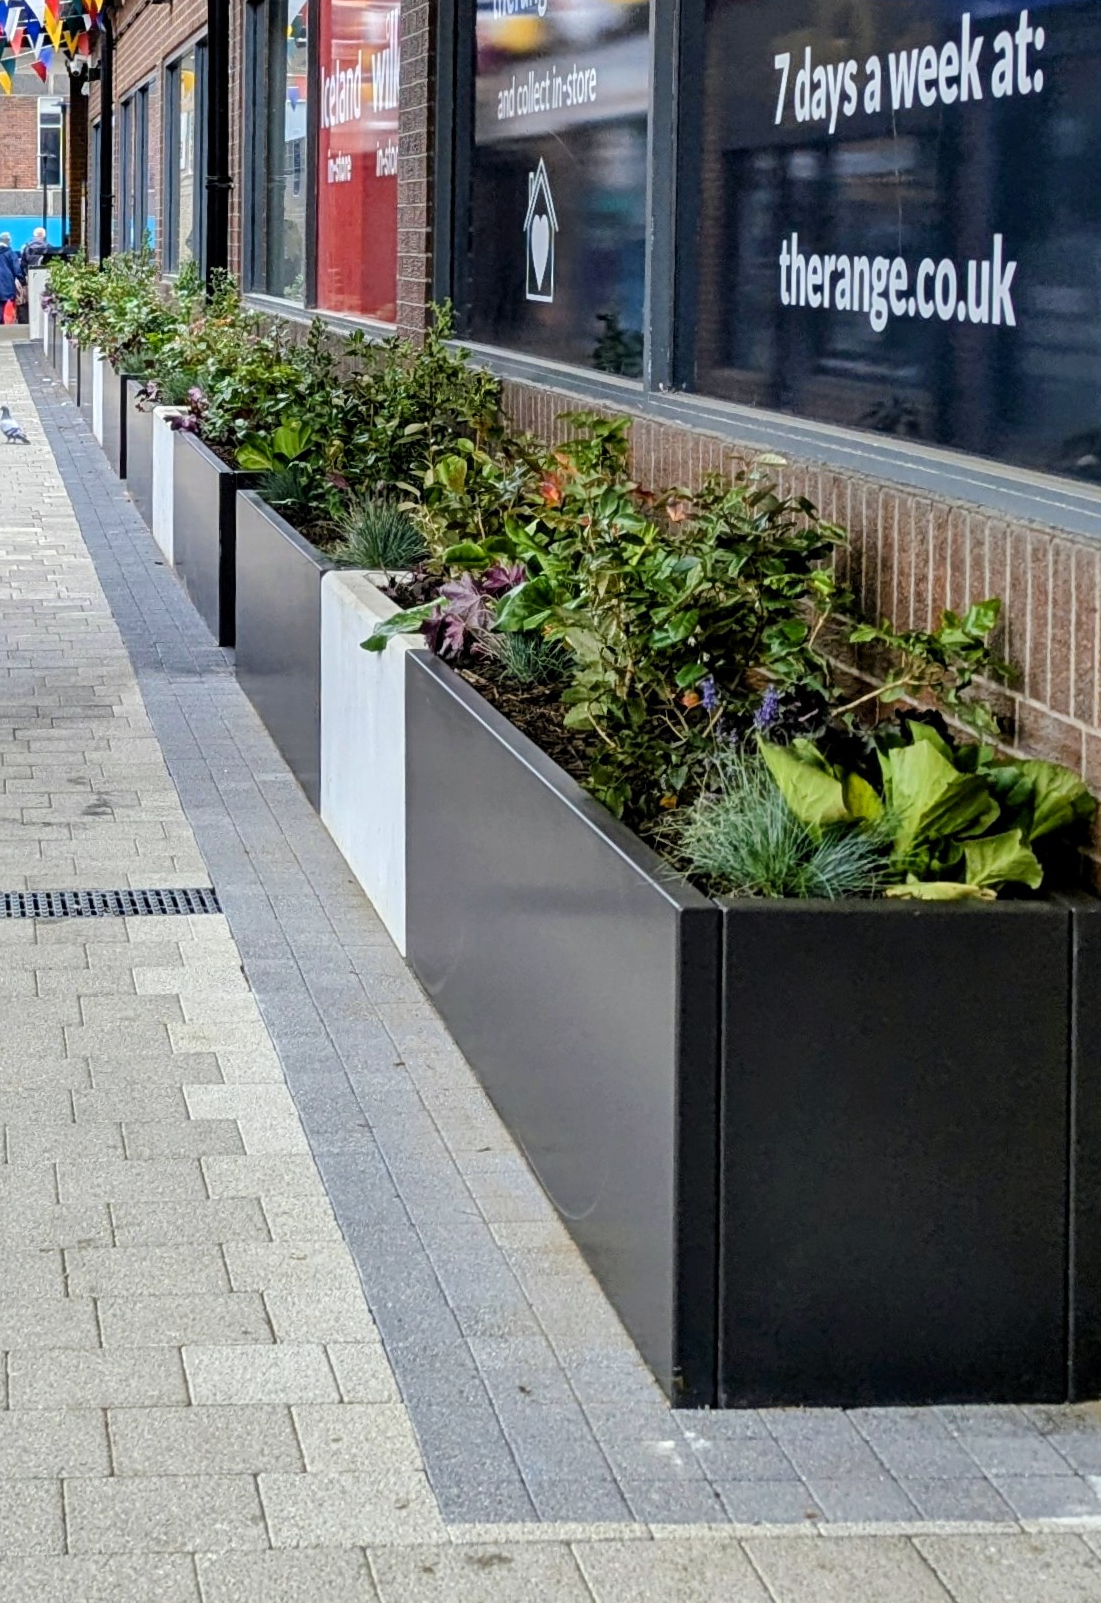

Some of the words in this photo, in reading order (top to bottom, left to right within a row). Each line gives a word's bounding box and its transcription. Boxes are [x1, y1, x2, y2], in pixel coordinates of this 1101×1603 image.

[320, 49, 363, 129] Iceland
[497, 75, 516, 121] and
[517, 69, 551, 116] collect
[552, 63, 598, 109] in-store
[774, 52, 791, 125] 7
[794, 45, 859, 135] days
[863, 54, 882, 115] a
[888, 11, 985, 111] week
[990, 8, 1046, 99] at:
[327, 149, 353, 184] in-store
[779, 231, 1017, 333] therange.co.uk
